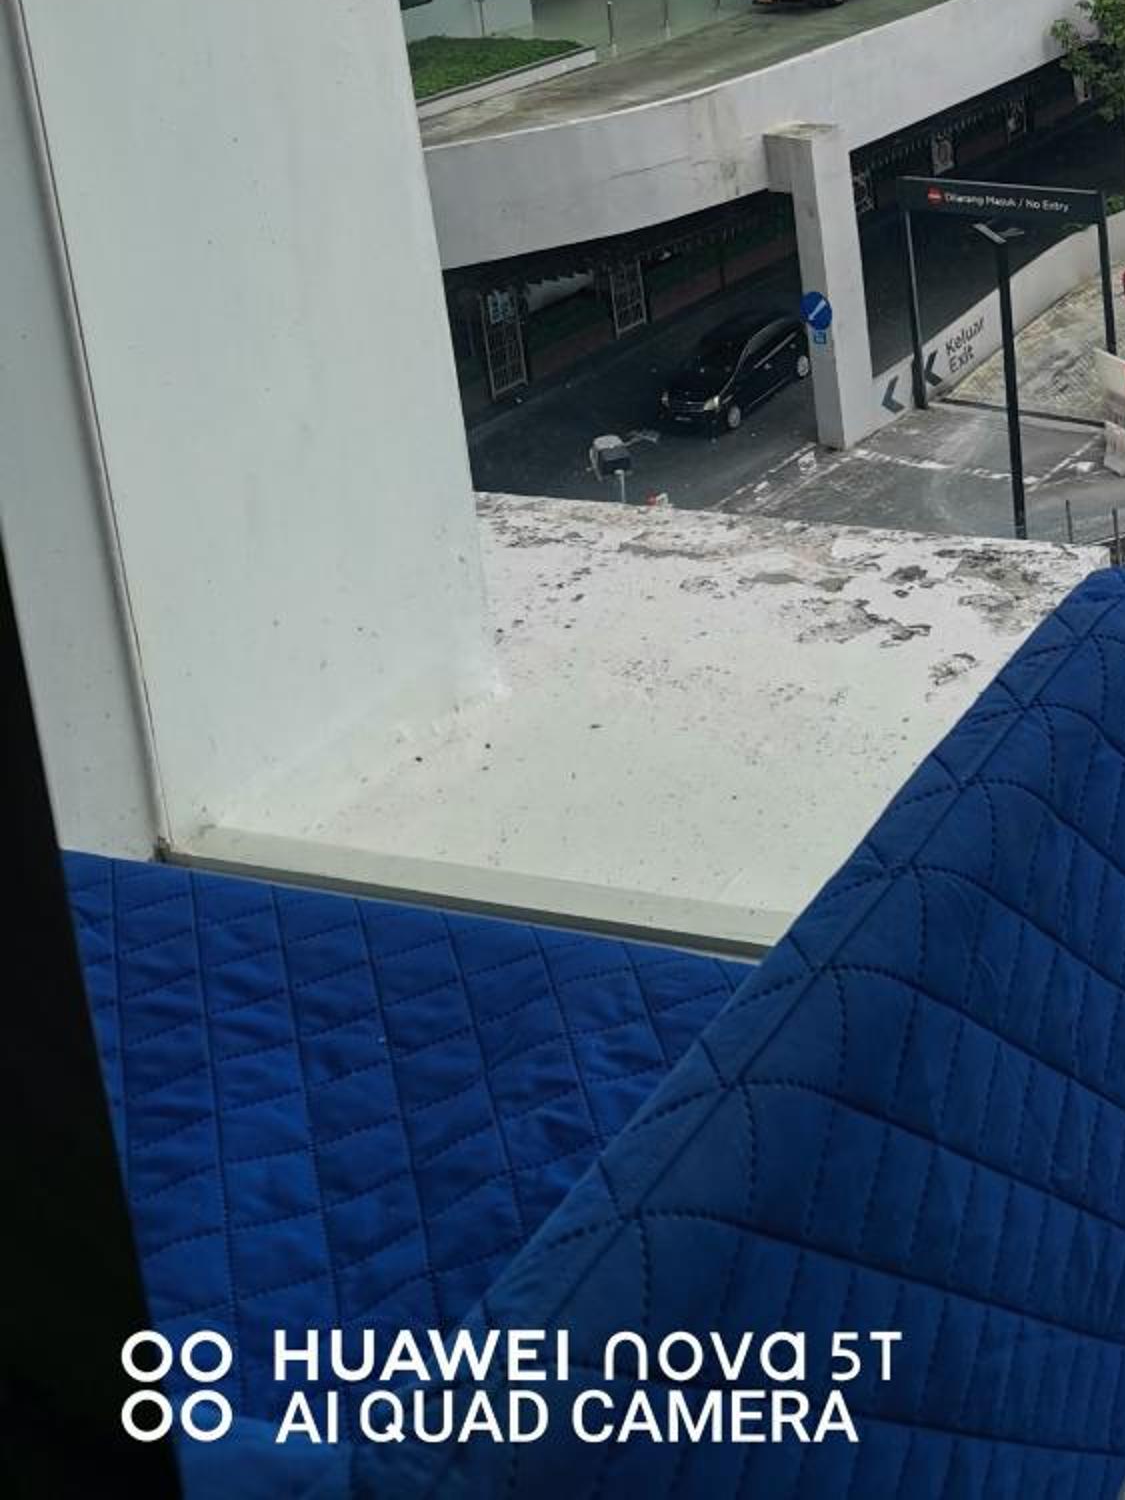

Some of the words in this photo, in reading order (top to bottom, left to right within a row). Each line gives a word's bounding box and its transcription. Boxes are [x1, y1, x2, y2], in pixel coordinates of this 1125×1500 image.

[1026, 198, 1041, 209] No
[1042, 200, 1069, 212] Entry
[945, 315, 985, 356] Keluar
